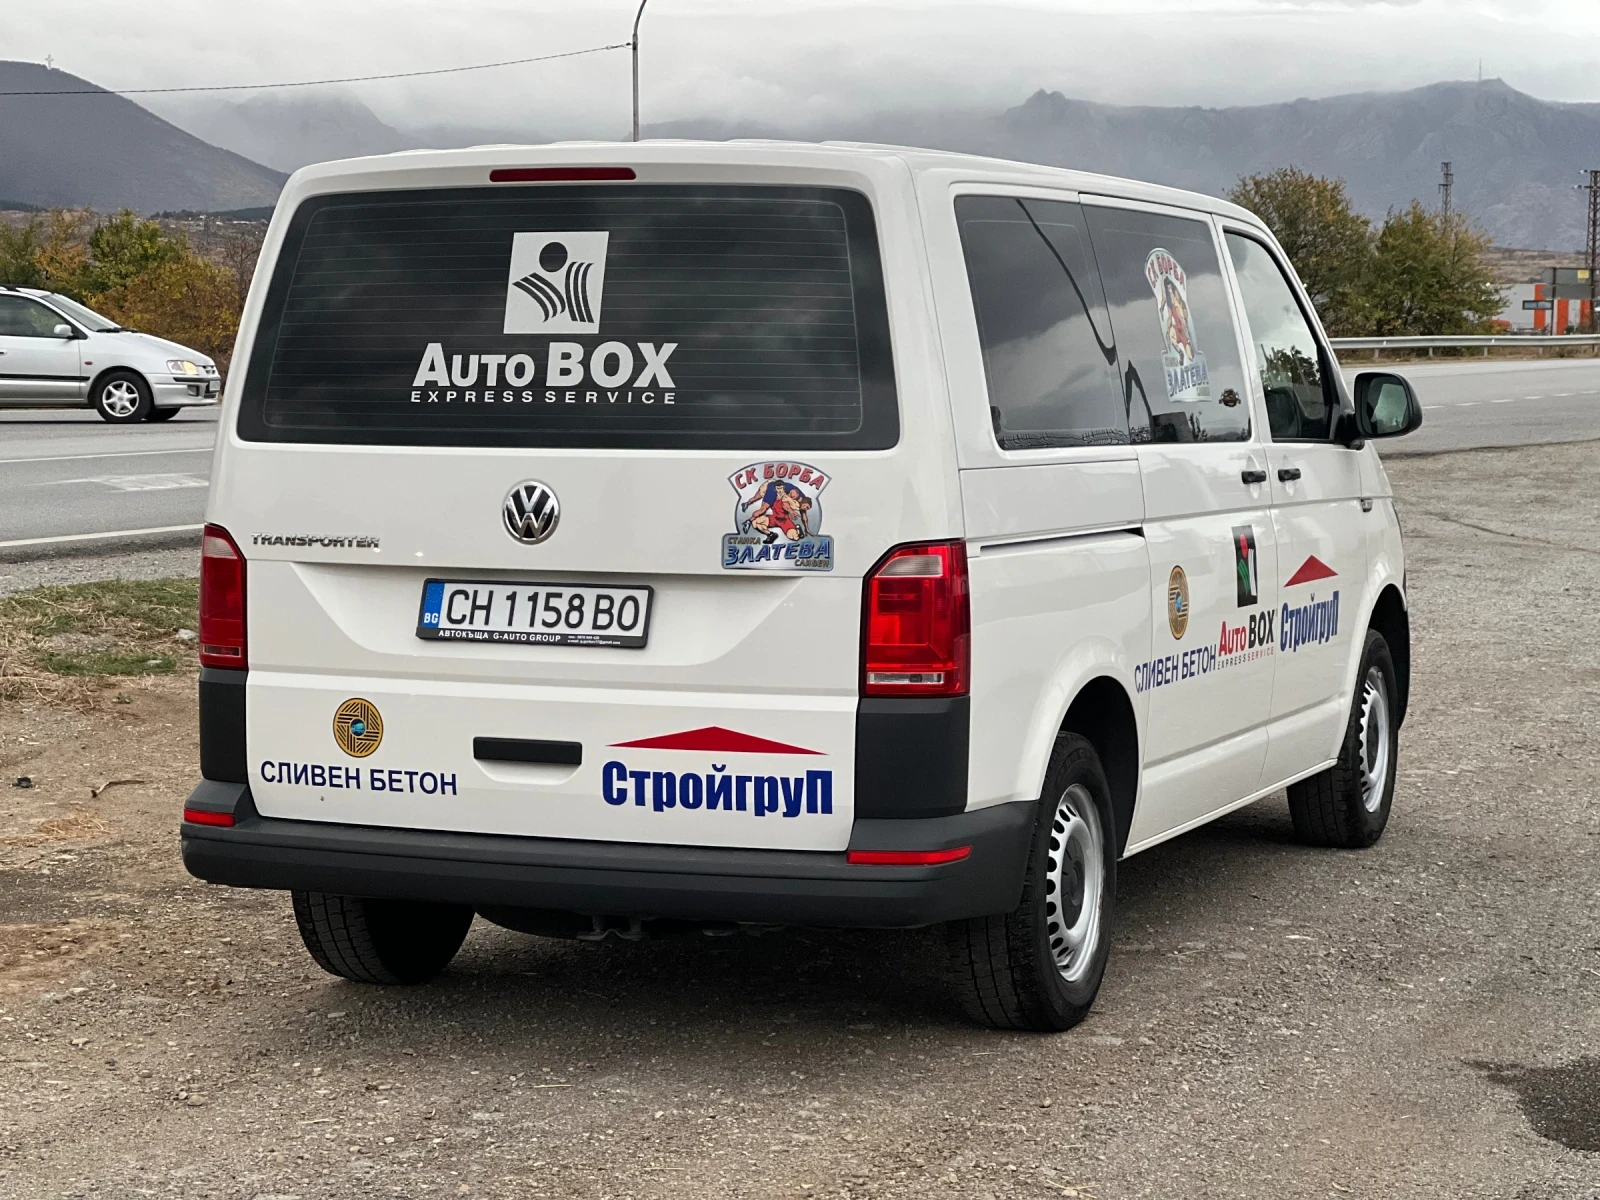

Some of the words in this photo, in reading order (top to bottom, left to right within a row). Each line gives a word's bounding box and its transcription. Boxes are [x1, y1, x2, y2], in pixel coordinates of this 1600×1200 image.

[546, 341, 678, 388] BOX
[1167, 364, 1209, 397] ЗЛАТЕВА
[411, 390, 533, 403] EXPRESS
[545, 391, 676, 404] SERVICE
[735, 467, 758, 490] СК
[763, 463, 825, 490] БОРБА
[251, 532, 380, 548] TRANSPORTER
[725, 540, 831, 566] ЗЛАТЕВА
[423, 612, 439, 624] BG
[505, 591, 585, 628] 1158
[438, 629, 489, 640] АВТОКЪЩА
[493, 632, 527, 641] G-AUTO
[529, 634, 561, 642] GROUP
[1248, 611, 1275, 649] BOX
[1134, 653, 1180, 694] СЛИВЕН
[1181, 644, 1217, 681] БЕТОН
[1217, 653, 1247, 670] EXPRESS
[1247, 646, 1274, 662] SERVICE
[260, 760, 361, 790] СЛИВЕН
[370, 768, 458, 795] БЕТОН
